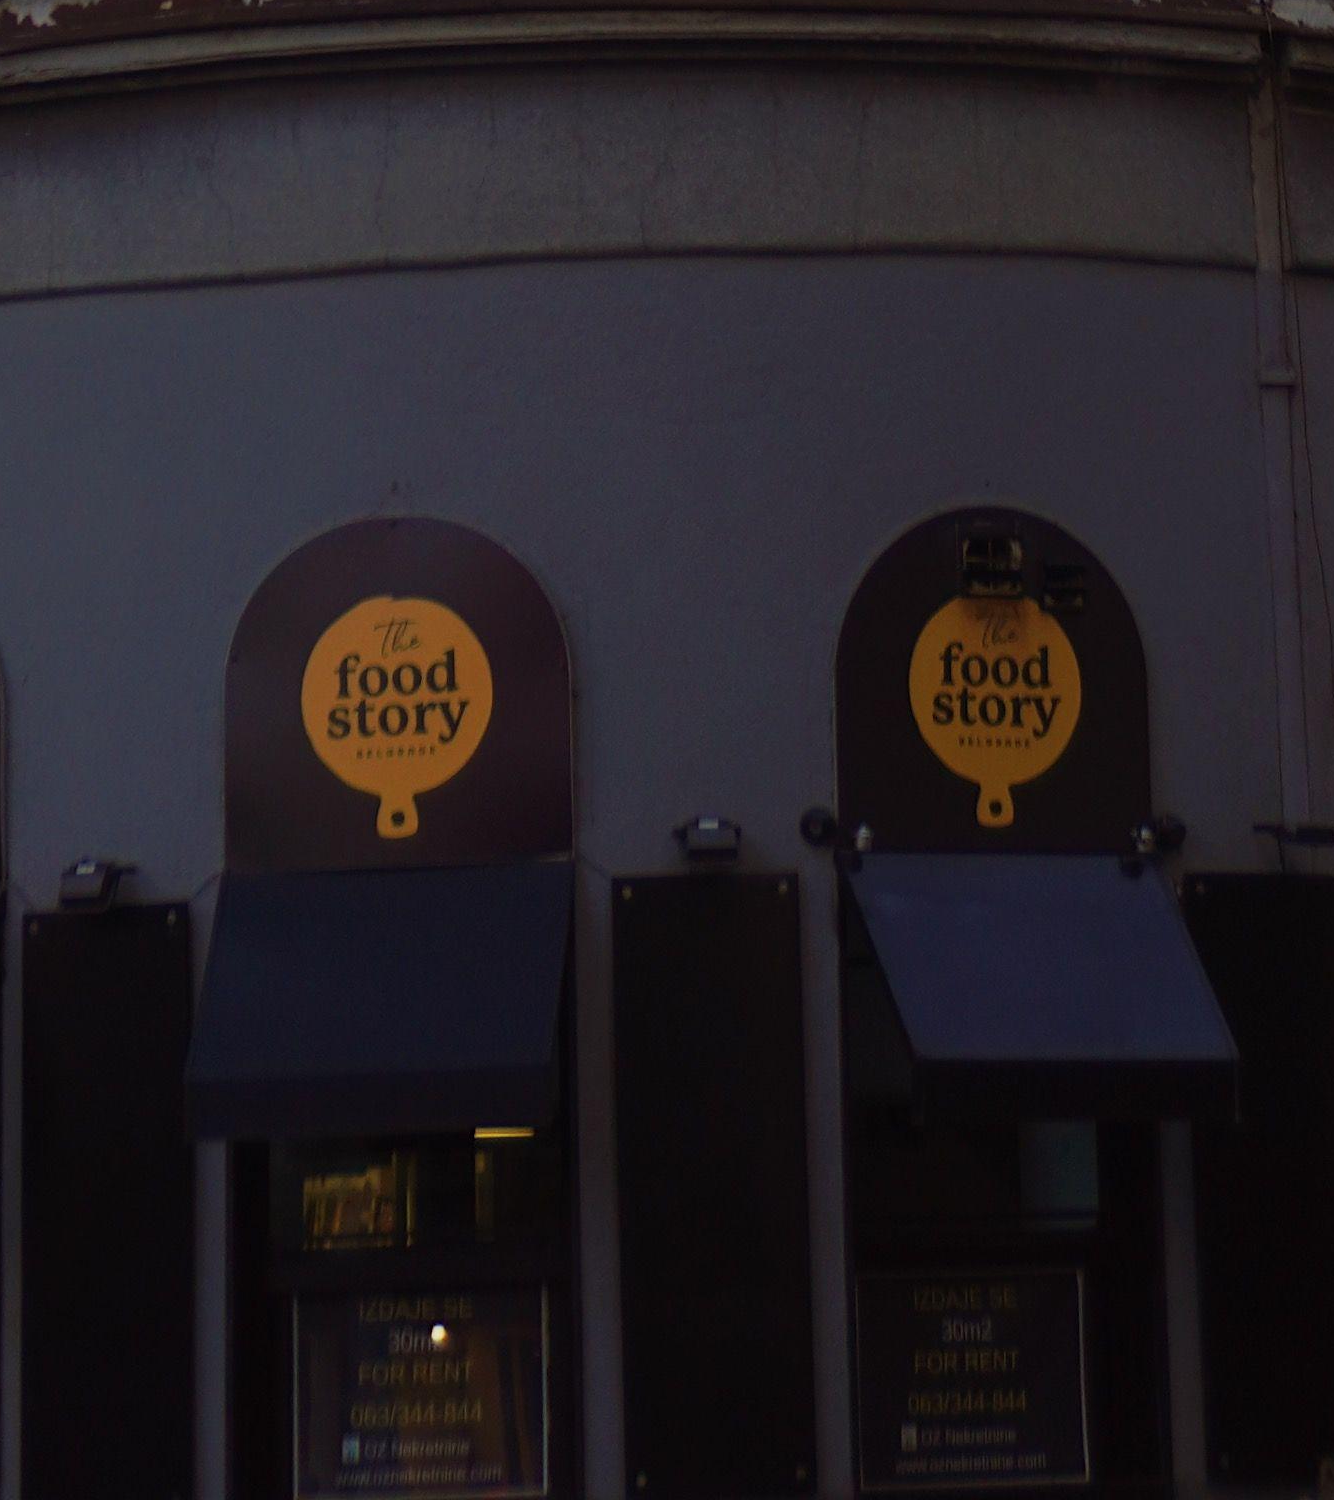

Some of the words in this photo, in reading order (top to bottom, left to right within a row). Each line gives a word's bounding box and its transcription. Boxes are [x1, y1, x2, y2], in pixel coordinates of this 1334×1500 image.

[334, 648, 457, 699] food
[939, 640, 1050, 688] food
[327, 699, 469, 743] story
[932, 688, 1061, 739] story
